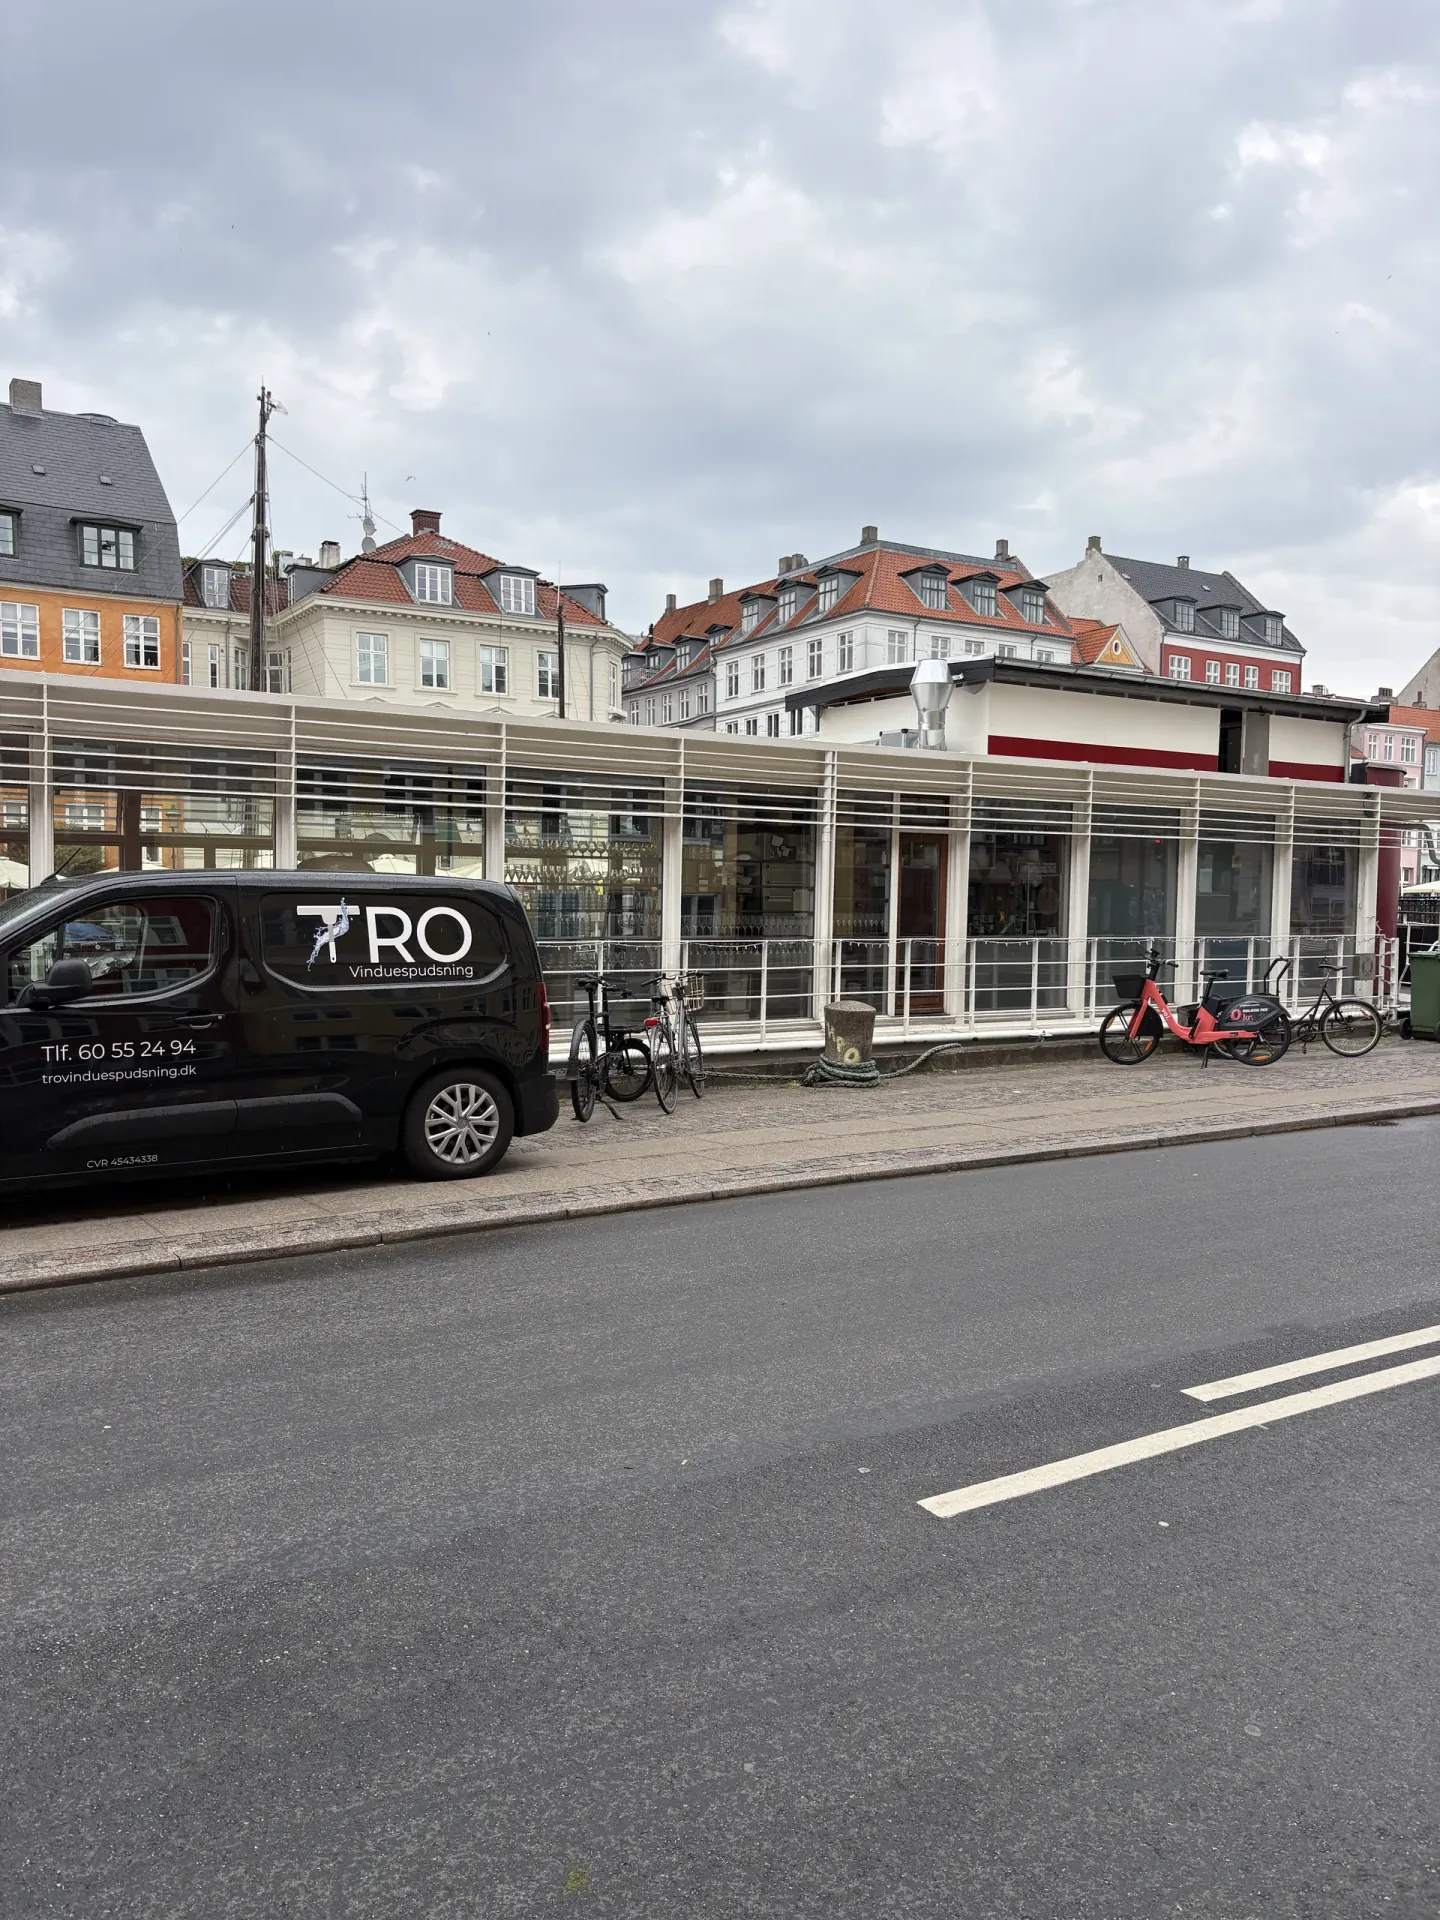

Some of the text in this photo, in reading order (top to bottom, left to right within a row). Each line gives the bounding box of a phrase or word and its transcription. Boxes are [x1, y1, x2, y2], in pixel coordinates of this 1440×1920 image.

[297, 905, 473, 963] TRO
[349, 964, 474, 979] Vinduespudsning
[41, 1039, 196, 1062] Tlf. 60 55 24 94
[42, 1064, 197, 1084] trovinduespudsning.dk
[86, 1154, 158, 1168] CVR 45434338
